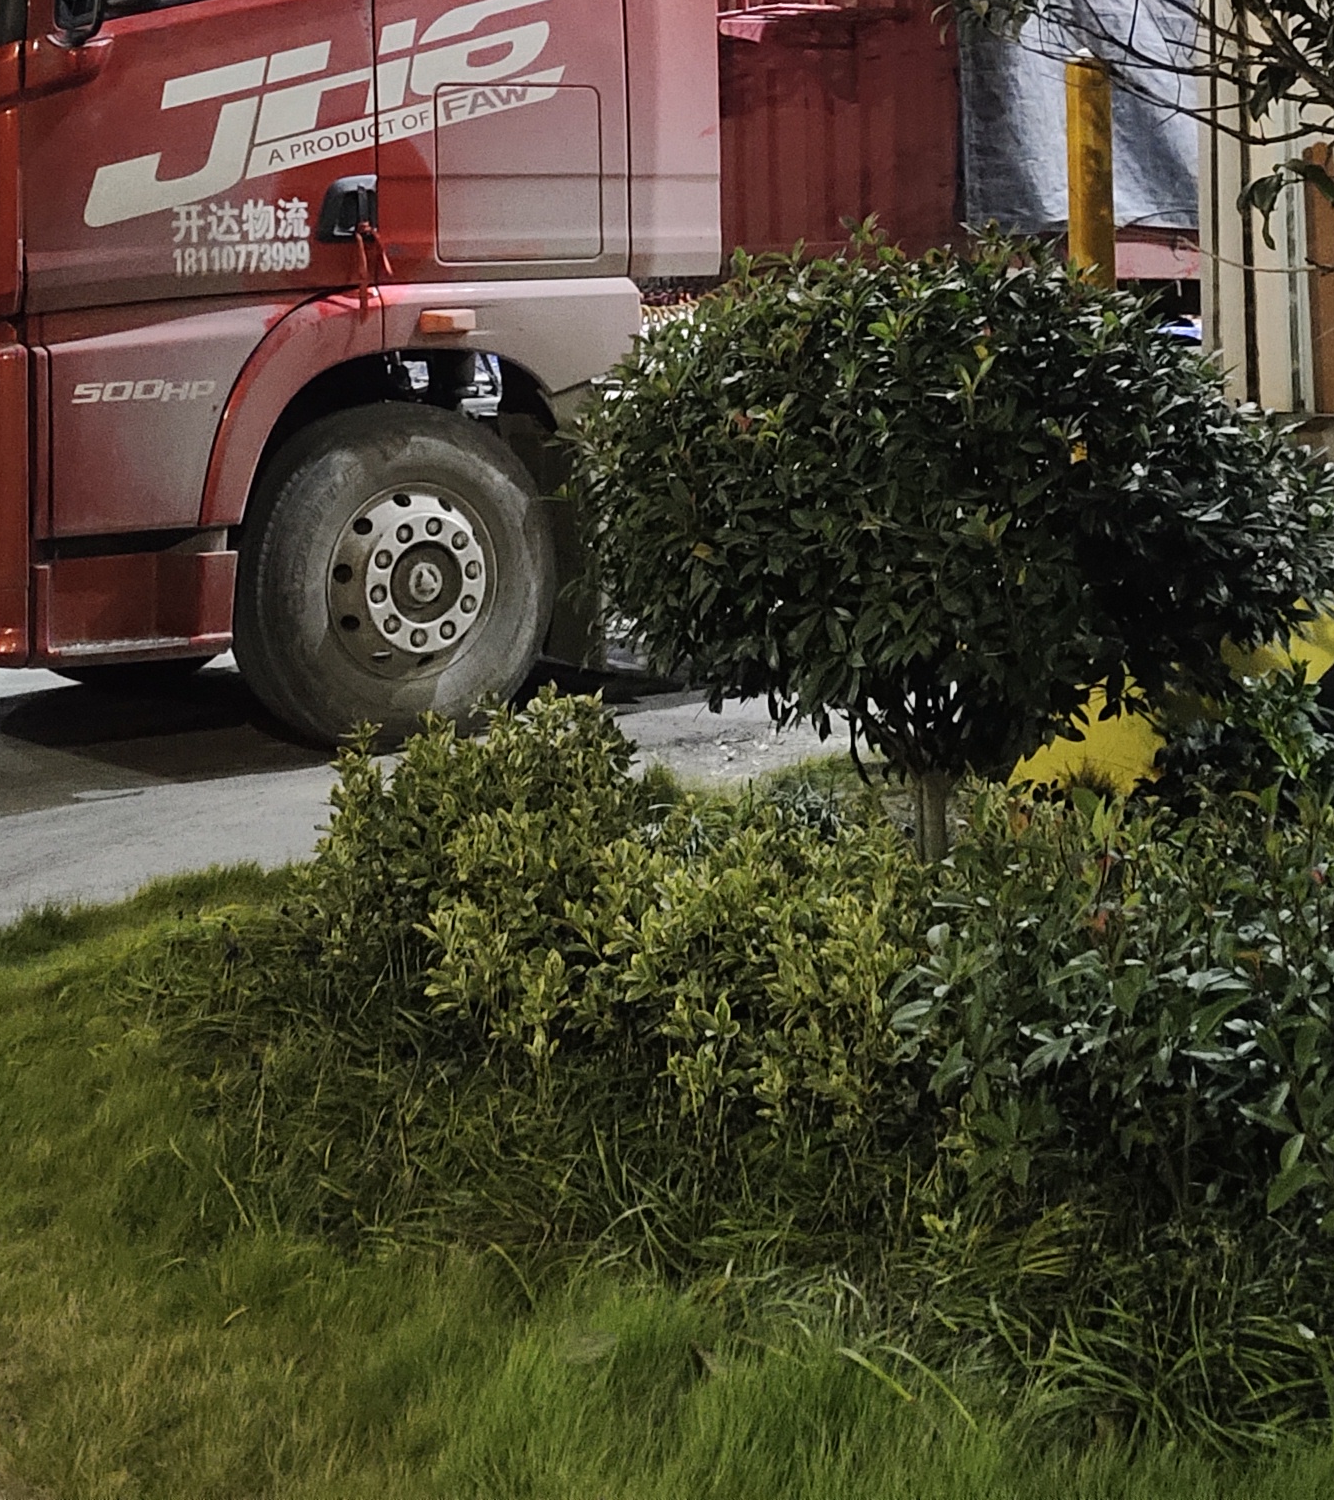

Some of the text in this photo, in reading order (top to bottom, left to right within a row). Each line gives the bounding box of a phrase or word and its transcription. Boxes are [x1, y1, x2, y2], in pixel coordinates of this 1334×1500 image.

[268, 80, 529, 166] A PRODUCT OF FAW
[171, 196, 311, 243] 开达物流
[173, 240, 310, 276] 18110773999
[71, 379, 217, 404] 500HP
